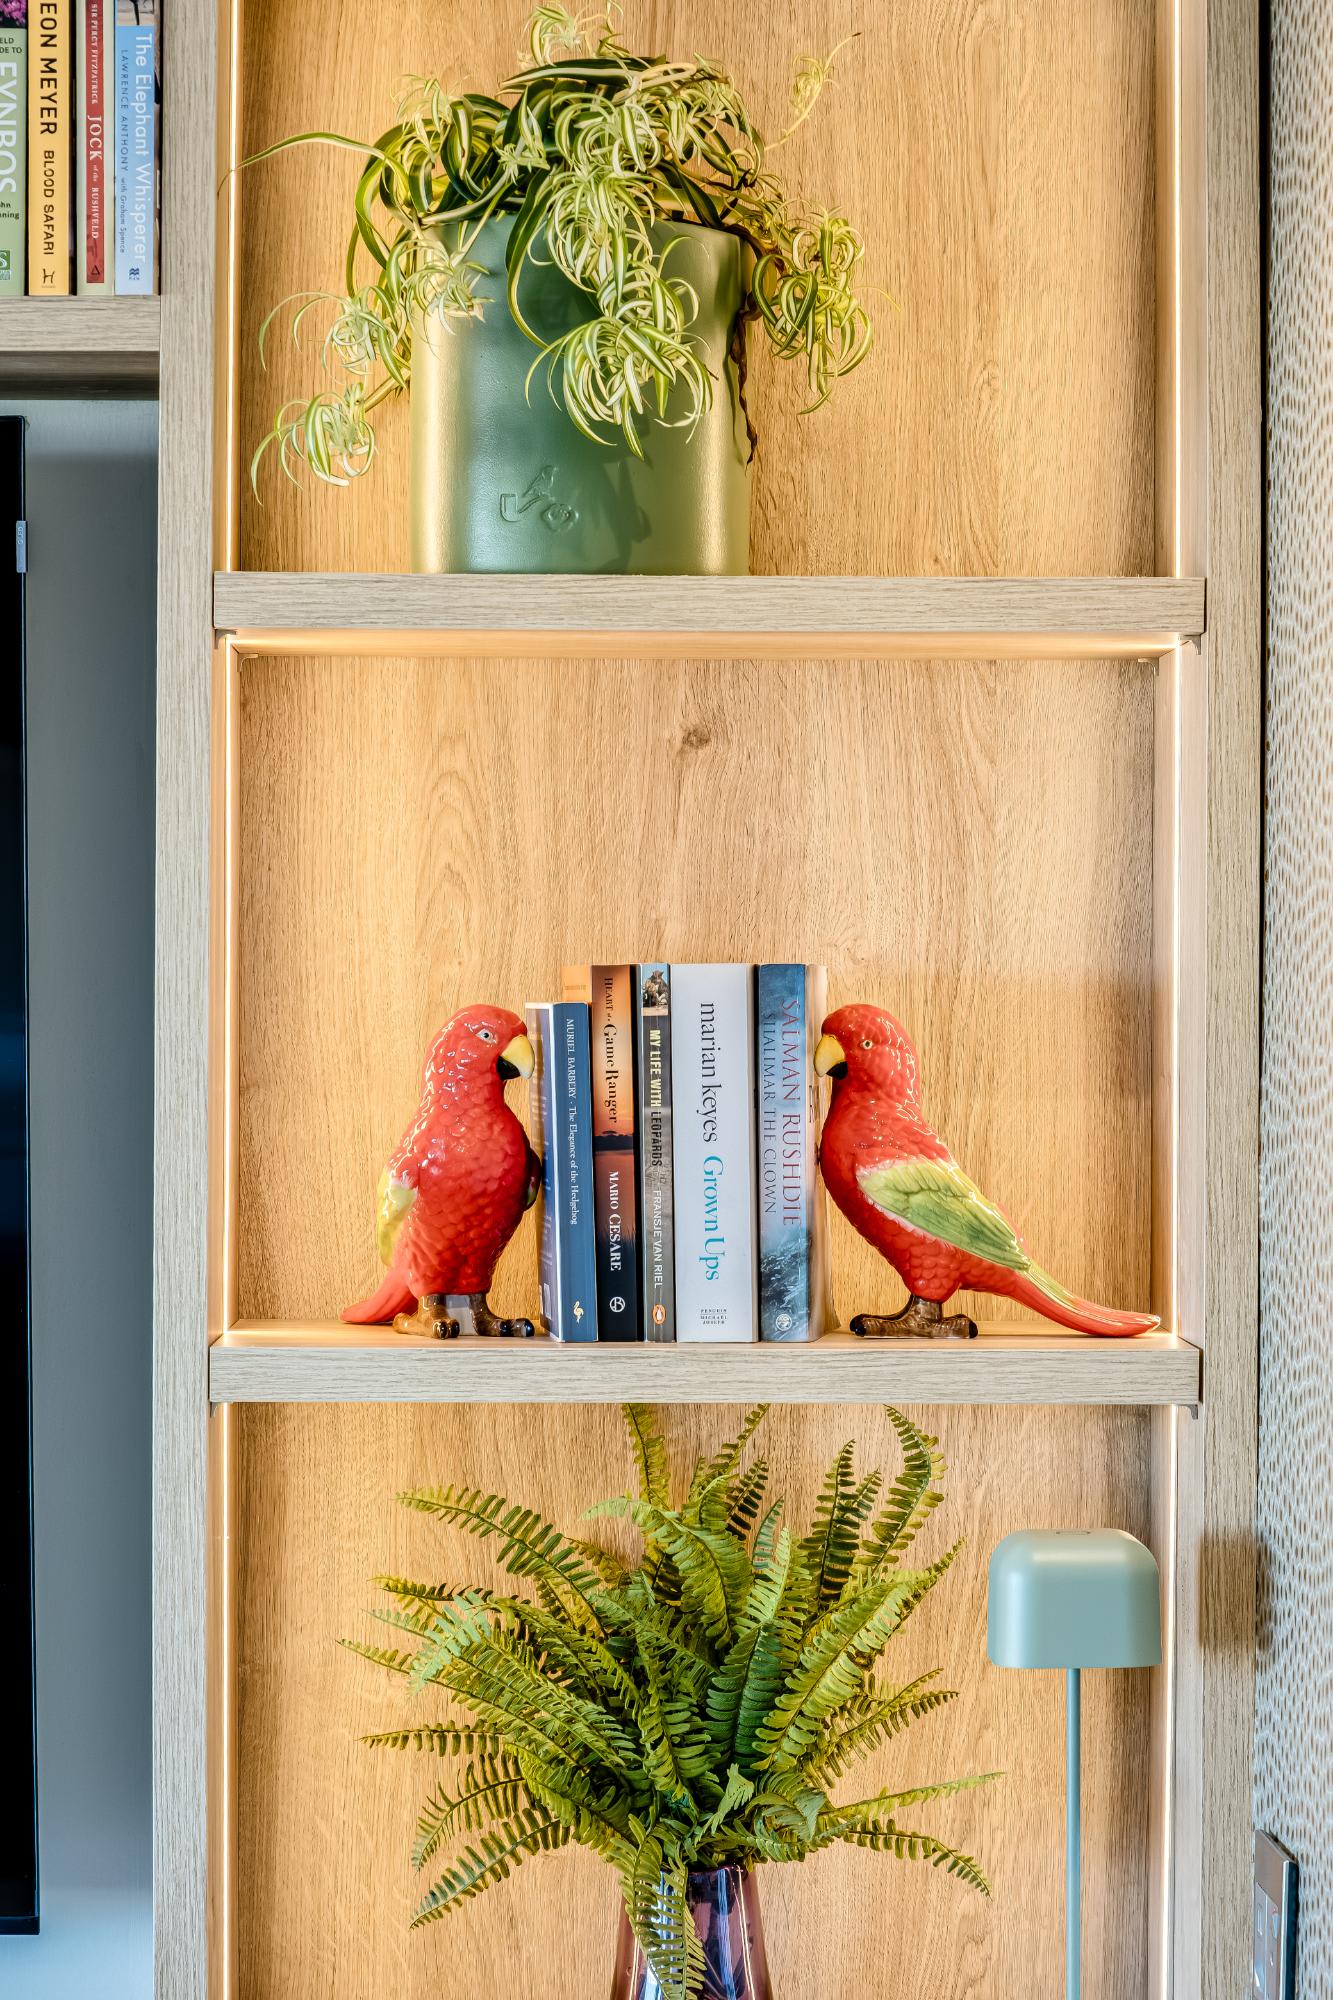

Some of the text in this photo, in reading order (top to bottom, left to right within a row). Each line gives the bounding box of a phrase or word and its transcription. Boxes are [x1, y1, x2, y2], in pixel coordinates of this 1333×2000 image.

[12, 46, 22, 54] TO
[120, 49, 129, 109] LAWRENCE
[135, 33, 152, 66] The
[40, 3, 57, 255] EON MEYER BLOOD SAFARI
[88, 115, 103, 160] JOCK
[120, 116, 129, 171] ANTHONY
[130, 74, 152, 156] Elephant
[91, 187, 99, 239] BUSHVELD
[129, 163, 152, 263] Whisperer
[603, 978, 619, 1123] HEART Game Ranger
[650, 1029, 662, 1167] MY LIFE WITH LEOPARDS
[696, 1002, 723, 1143] marian keyes
[565, 1018, 580, 1225] MURIEL BARBERY The Elegance of the Hedgehog
[763, 1012, 777, 1213] SHALIMAR THE CLOWN
[782, 1000, 802, 1226] SALMAN RUSHDIE
[609, 1171, 622, 1271] MARIO CESARE
[653, 1190, 663, 1289] FRANSJE VAN RIEL
[699, 1155, 726, 1281] Grown Ups
